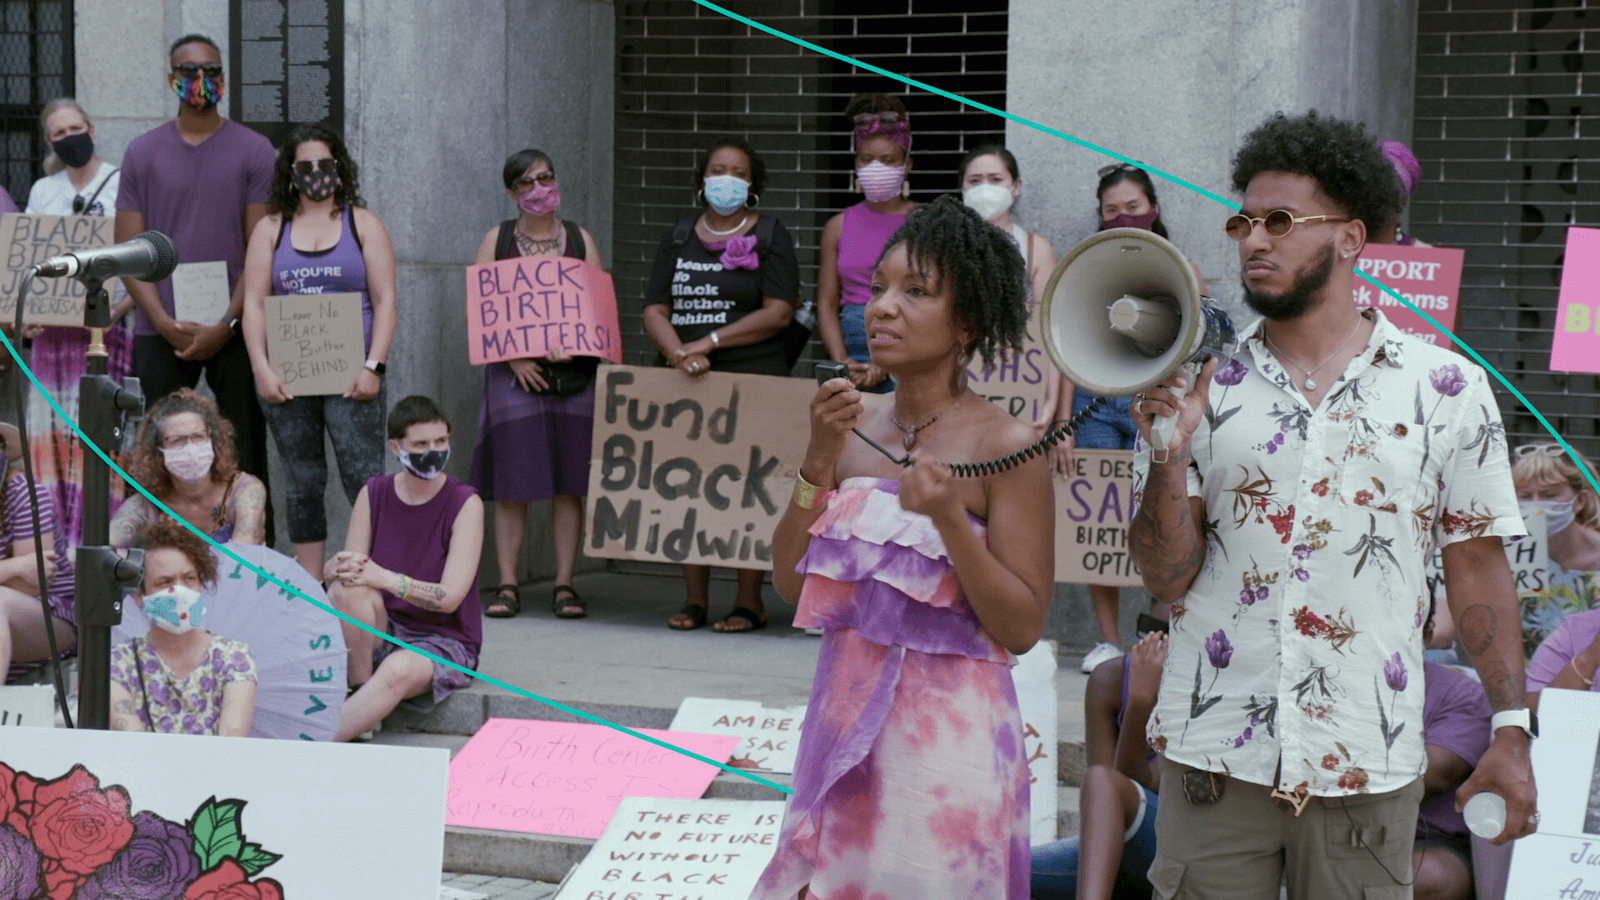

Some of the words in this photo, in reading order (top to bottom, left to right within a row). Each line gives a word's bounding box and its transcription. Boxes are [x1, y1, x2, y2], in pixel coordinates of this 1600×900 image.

[12, 215, 107, 245] BLACK
[279, 270, 289, 281] IF
[292, 266, 342, 278] YOU'RE
[676, 257, 724, 272] Leave
[281, 279, 305, 290] NOT
[478, 260, 584, 298] BLACK
[672, 271, 690, 283] No
[671, 283, 720, 296] Black
[672, 298, 736, 310] Mother
[1379, 288, 1449, 310] Moms
[279, 300, 312, 321] Leave
[319, 301, 340, 319] No
[481, 291, 581, 327] BIRTH
[670, 312, 727, 326] Behind
[1565, 303, 1600, 335] B
[278, 324, 330, 342] BLACK
[481, 322, 611, 359] MATTERS!
[279, 360, 349, 385] BEHIND
[604, 371, 740, 445] Fund
[601, 433, 780, 516] Black
[1066, 478, 1135, 524] SA
[712, 714, 804, 732] AMBE
[495, 726, 578, 764] Birth
[592, 736, 674, 767] Center
[637, 811, 731, 825] THERE
[754, 814, 778, 826] IS
[624, 830, 662, 842] NO
[678, 832, 775, 845] FUTURE
[609, 851, 740, 864] WITHOUT
[601, 868, 729, 885] BLACK
